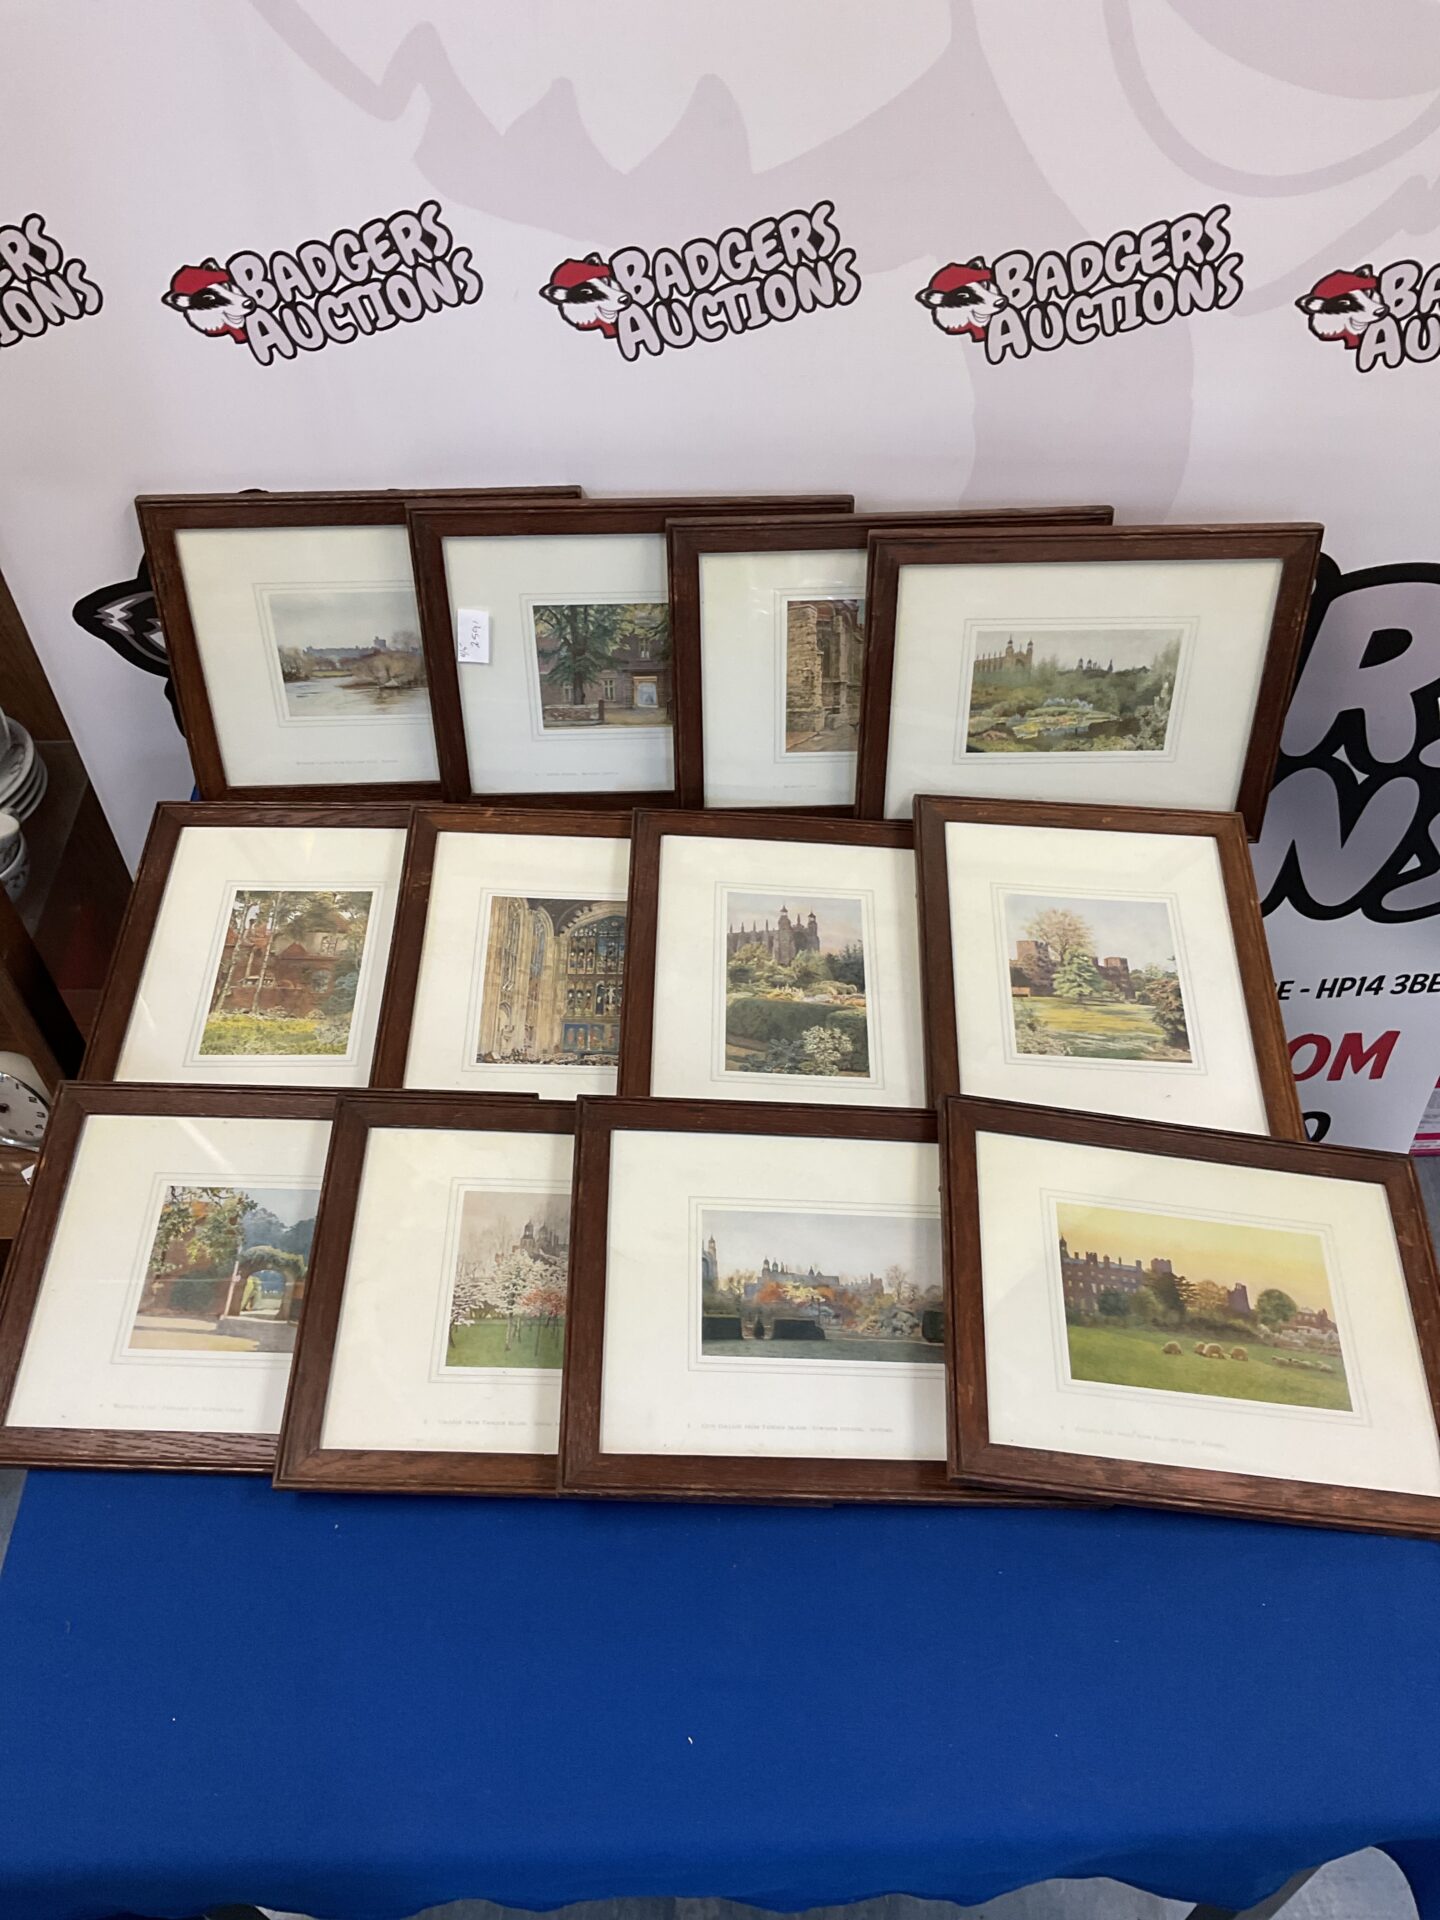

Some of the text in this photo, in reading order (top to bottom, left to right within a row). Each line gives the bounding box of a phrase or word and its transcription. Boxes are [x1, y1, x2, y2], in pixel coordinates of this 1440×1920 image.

[0, 213, 63, 284] RS
[226, 200, 453, 313] BADGERS
[609, 200, 840, 307] BADGERS
[992, 204, 1231, 312] BADGERS
[245, 247, 483, 367] AUCTIONS
[617, 248, 861, 362] AUCTIONS
[984, 252, 1244, 365] AUCTIONS
[1275, 980, 1295, 1000] E
[1315, 974, 1386, 999] HP14
[1389, 973, 1440, 995] 3BE
